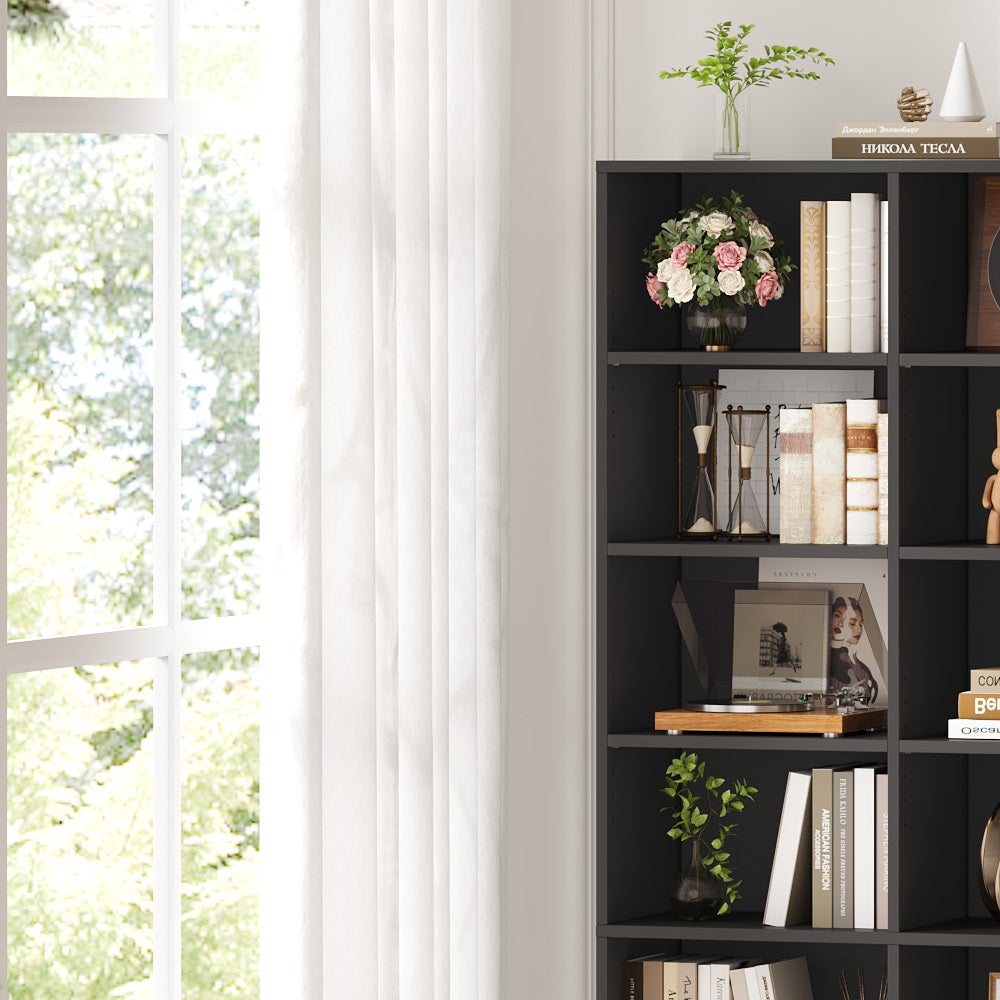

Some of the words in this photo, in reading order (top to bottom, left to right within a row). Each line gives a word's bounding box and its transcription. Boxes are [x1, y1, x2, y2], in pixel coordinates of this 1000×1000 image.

[861, 143, 916, 154] НИКОЛА
[920, 143, 966, 154] ТЕСЛА
[839, 778, 847, 799] FRIDA
[839, 801, 847, 825] KAHLO
[821, 809, 830, 852] AMERICAN
[821, 854, 830, 891] FASHION
[683, 975, 692, 994] The
[716, 977, 725, 1000] Karen
